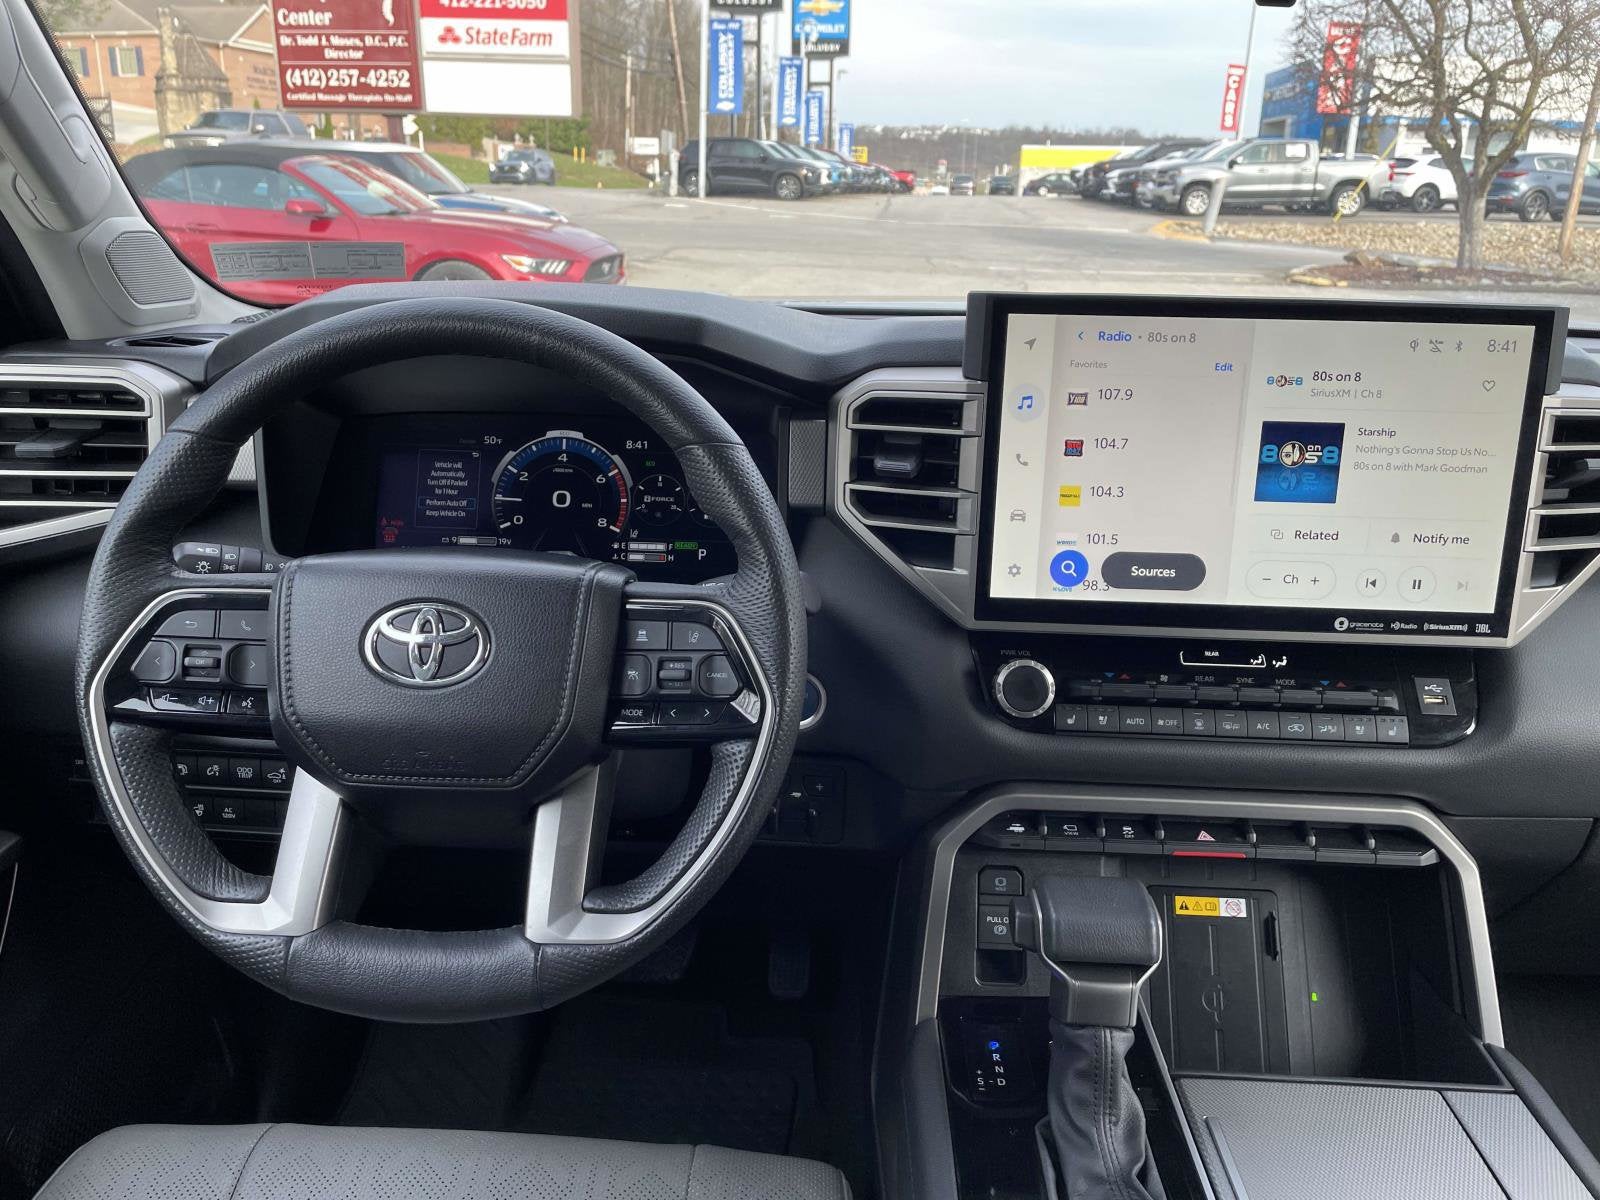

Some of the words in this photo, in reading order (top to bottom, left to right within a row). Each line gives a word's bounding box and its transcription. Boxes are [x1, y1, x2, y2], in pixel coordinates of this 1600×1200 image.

[439, 0, 548, 10] 412-221-5050
[277, 8, 333, 26] Center
[279, 34, 295, 47] Dr.
[296, 34, 319, 46] Todd
[324, 48, 364, 60] Director
[1224, 76, 1240, 127] CARS
[1097, 331, 1132, 342] Radio
[1148, 331, 1167, 343] 80s
[1170, 334, 1185, 343] on
[1188, 333, 1196, 343] 8
[1487, 339, 1517, 353] 8:41
[1070, 359, 1108, 369] Favorites
[1215, 362, 1233, 372] Edit
[1312, 371, 1333, 382] 80s
[1336, 373, 1351, 382] on
[1354, 372, 1362, 382] 8
[1098, 388, 1133, 401] 107.9
[1310, 388, 1350, 398] SiriusXM
[1361, 389, 1373, 398] Ch
[1376, 389, 1382, 399] 8
[1358, 427, 1396, 438] Starship
[626, 440, 648, 450] 8:41
[1094, 438, 1128, 450] 104.7
[1355, 444, 1400, 456] Nothing's
[1402, 446, 1434, 455] Gonna
[1436, 446, 1458, 457] Stop
[1460, 448, 1472, 456] Us
[557, 453, 568, 462] 4
[1354, 461, 1370, 471] 80s
[1385, 462, 1391, 471] 8
[1393, 463, 1413, 472] with
[1415, 463, 1438, 472] Mark
[1440, 464, 1488, 473] Goodman
[431, 470, 465, 479] Automatically
[519, 472, 529, 481] 2
[596, 475, 606, 484] 6
[1090, 486, 1124, 498] 104.3
[552, 490, 571, 508] 0
[513, 515, 523, 525] 0
[597, 518, 607, 527] 8
[1086, 533, 1118, 545] 101.5
[1294, 530, 1339, 541] Related
[1413, 533, 1449, 546] Notify
[1451, 536, 1469, 545] me
[699, 549, 706, 560] P
[1131, 566, 1176, 577] Sources
[1283, 574, 1298, 585] Ch
[1082, 580, 1110, 592] 98.3
[1475, 623, 1491, 633] JBL
[621, 709, 643, 717] MODE
[1126, 718, 1145, 726] AUTO
[992, 1053, 1001, 1061] R
[977, 1077, 984, 1085] S
[997, 1078, 1006, 1086] D
